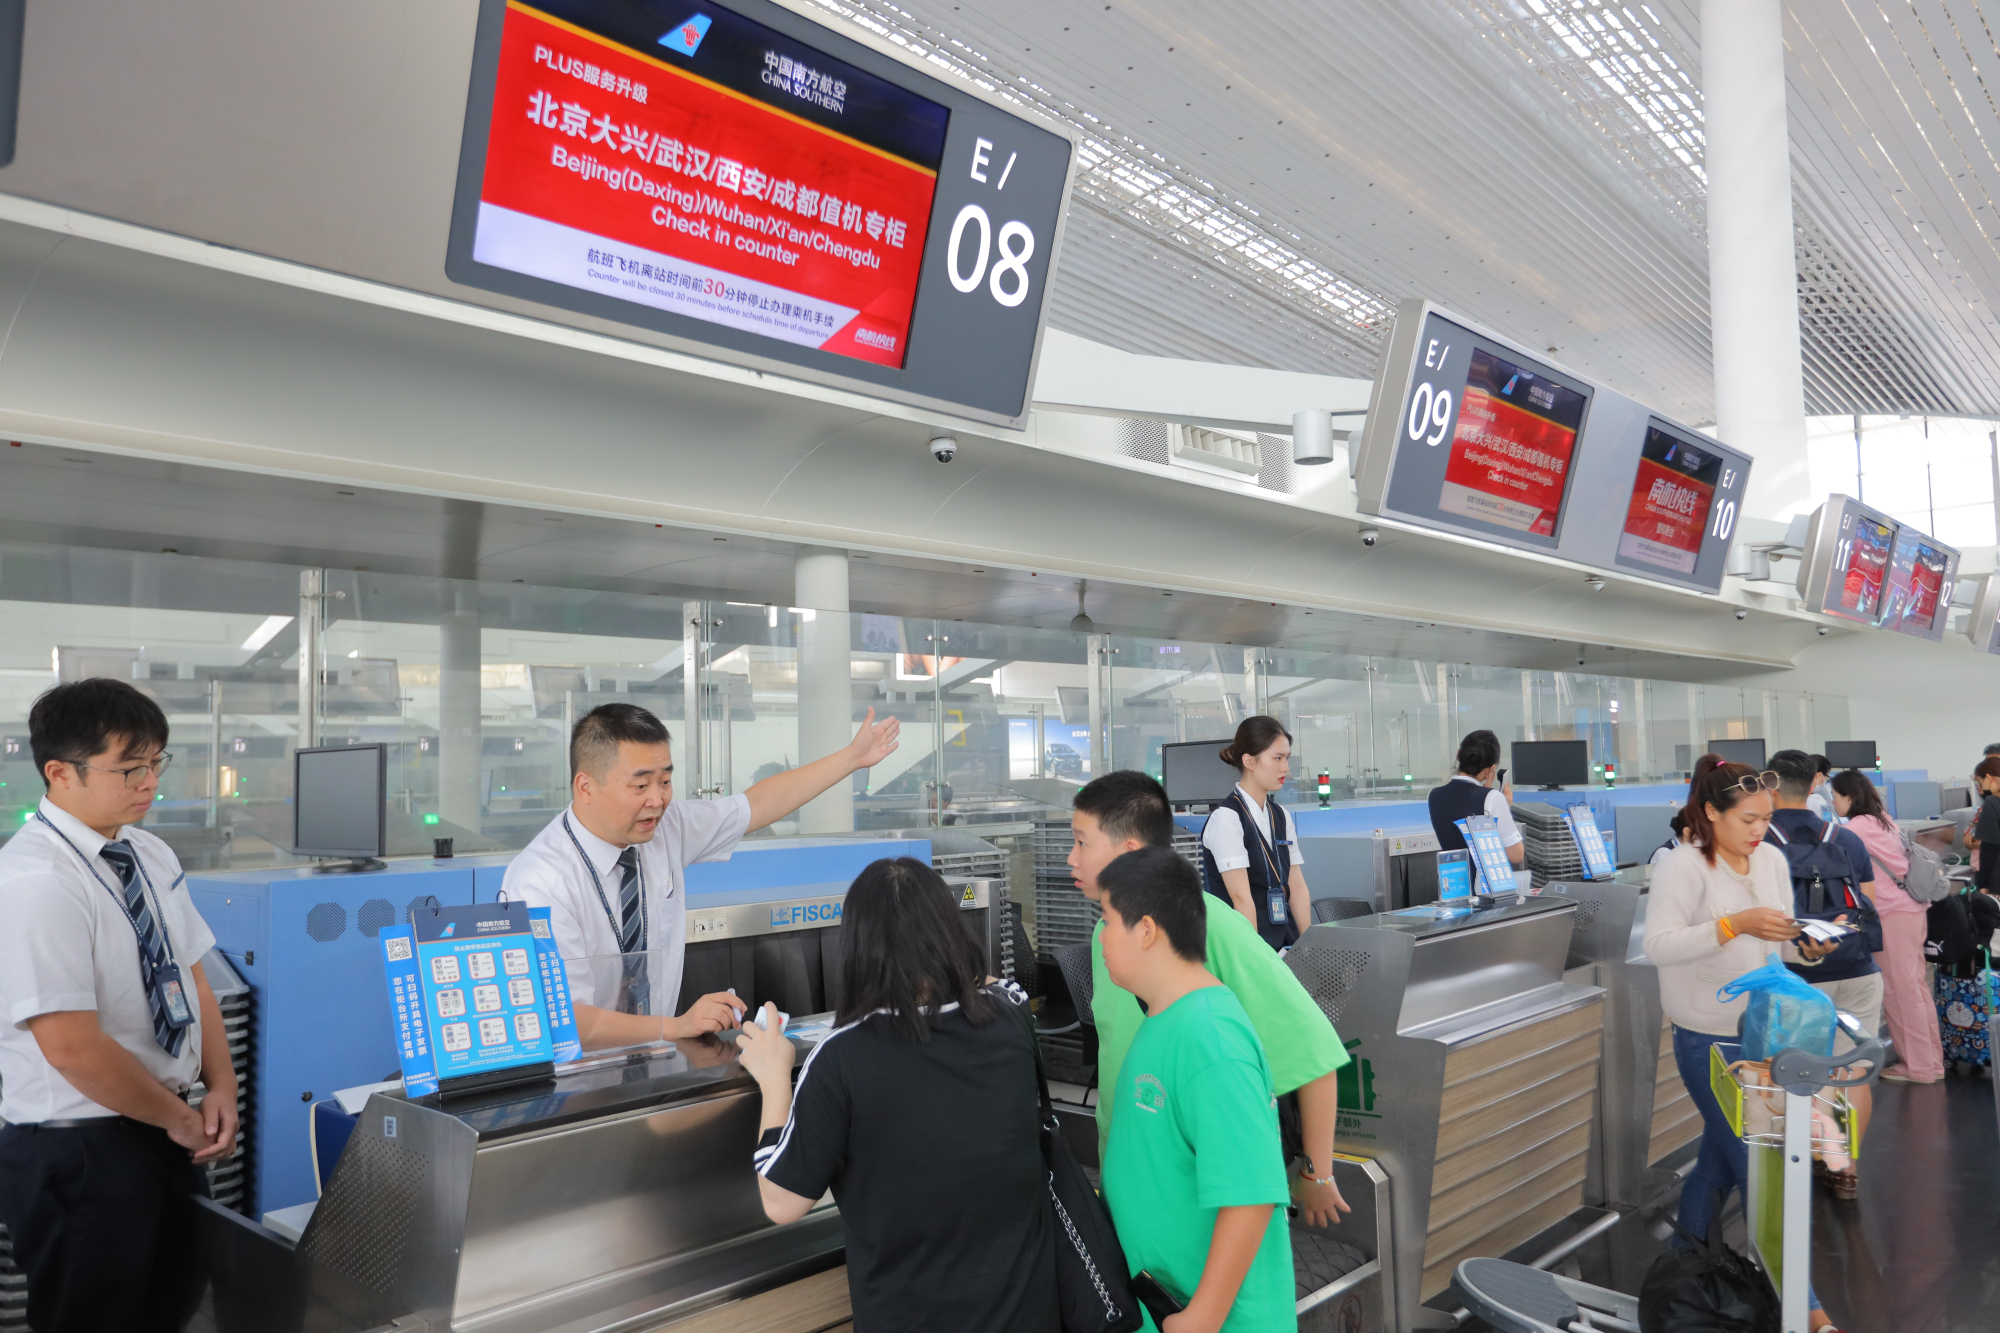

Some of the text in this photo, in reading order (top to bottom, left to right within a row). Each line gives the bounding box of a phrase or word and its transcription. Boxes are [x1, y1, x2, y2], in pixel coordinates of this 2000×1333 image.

[534, 45, 649, 105] PLUS服务升级
[761, 70, 844, 115] CHINA SOUTHERN
[763, 50, 847, 101] 中国南方航空
[527, 90, 907, 249] 北京大兴/武汉/西安/成都值机专柜
[651, 205, 800, 267] Check in counter
[947, 203, 1035, 308] 08
[588, 268, 830, 341] Counter will be closed 30 minutes before schedule time of departure
[1424, 338, 1450, 372] E/
[1408, 381, 1452, 447] 09
[1487, 470, 1529, 491] Check in counter
[1647, 477, 1699, 516] 南航快线
[1722, 468, 1737, 490] E/
[1712, 498, 1735, 540] 10
[1835, 538, 1852, 572] 11
[1940, 581, 1952, 608] 12
[792, 903, 844, 924] FISCA
[539, 952, 559, 1028] 您在柜台所支付费用
[549, 951, 570, 1026] 可扫码开具电子发票
[393, 977, 414, 1059] 您在柜台所支付费用
[406, 974, 428, 1056] 可扫码开具电子发票
[1335, 1129, 1377, 1139] gage wheels
[1336, 1116, 1361, 1128] 子朝外
